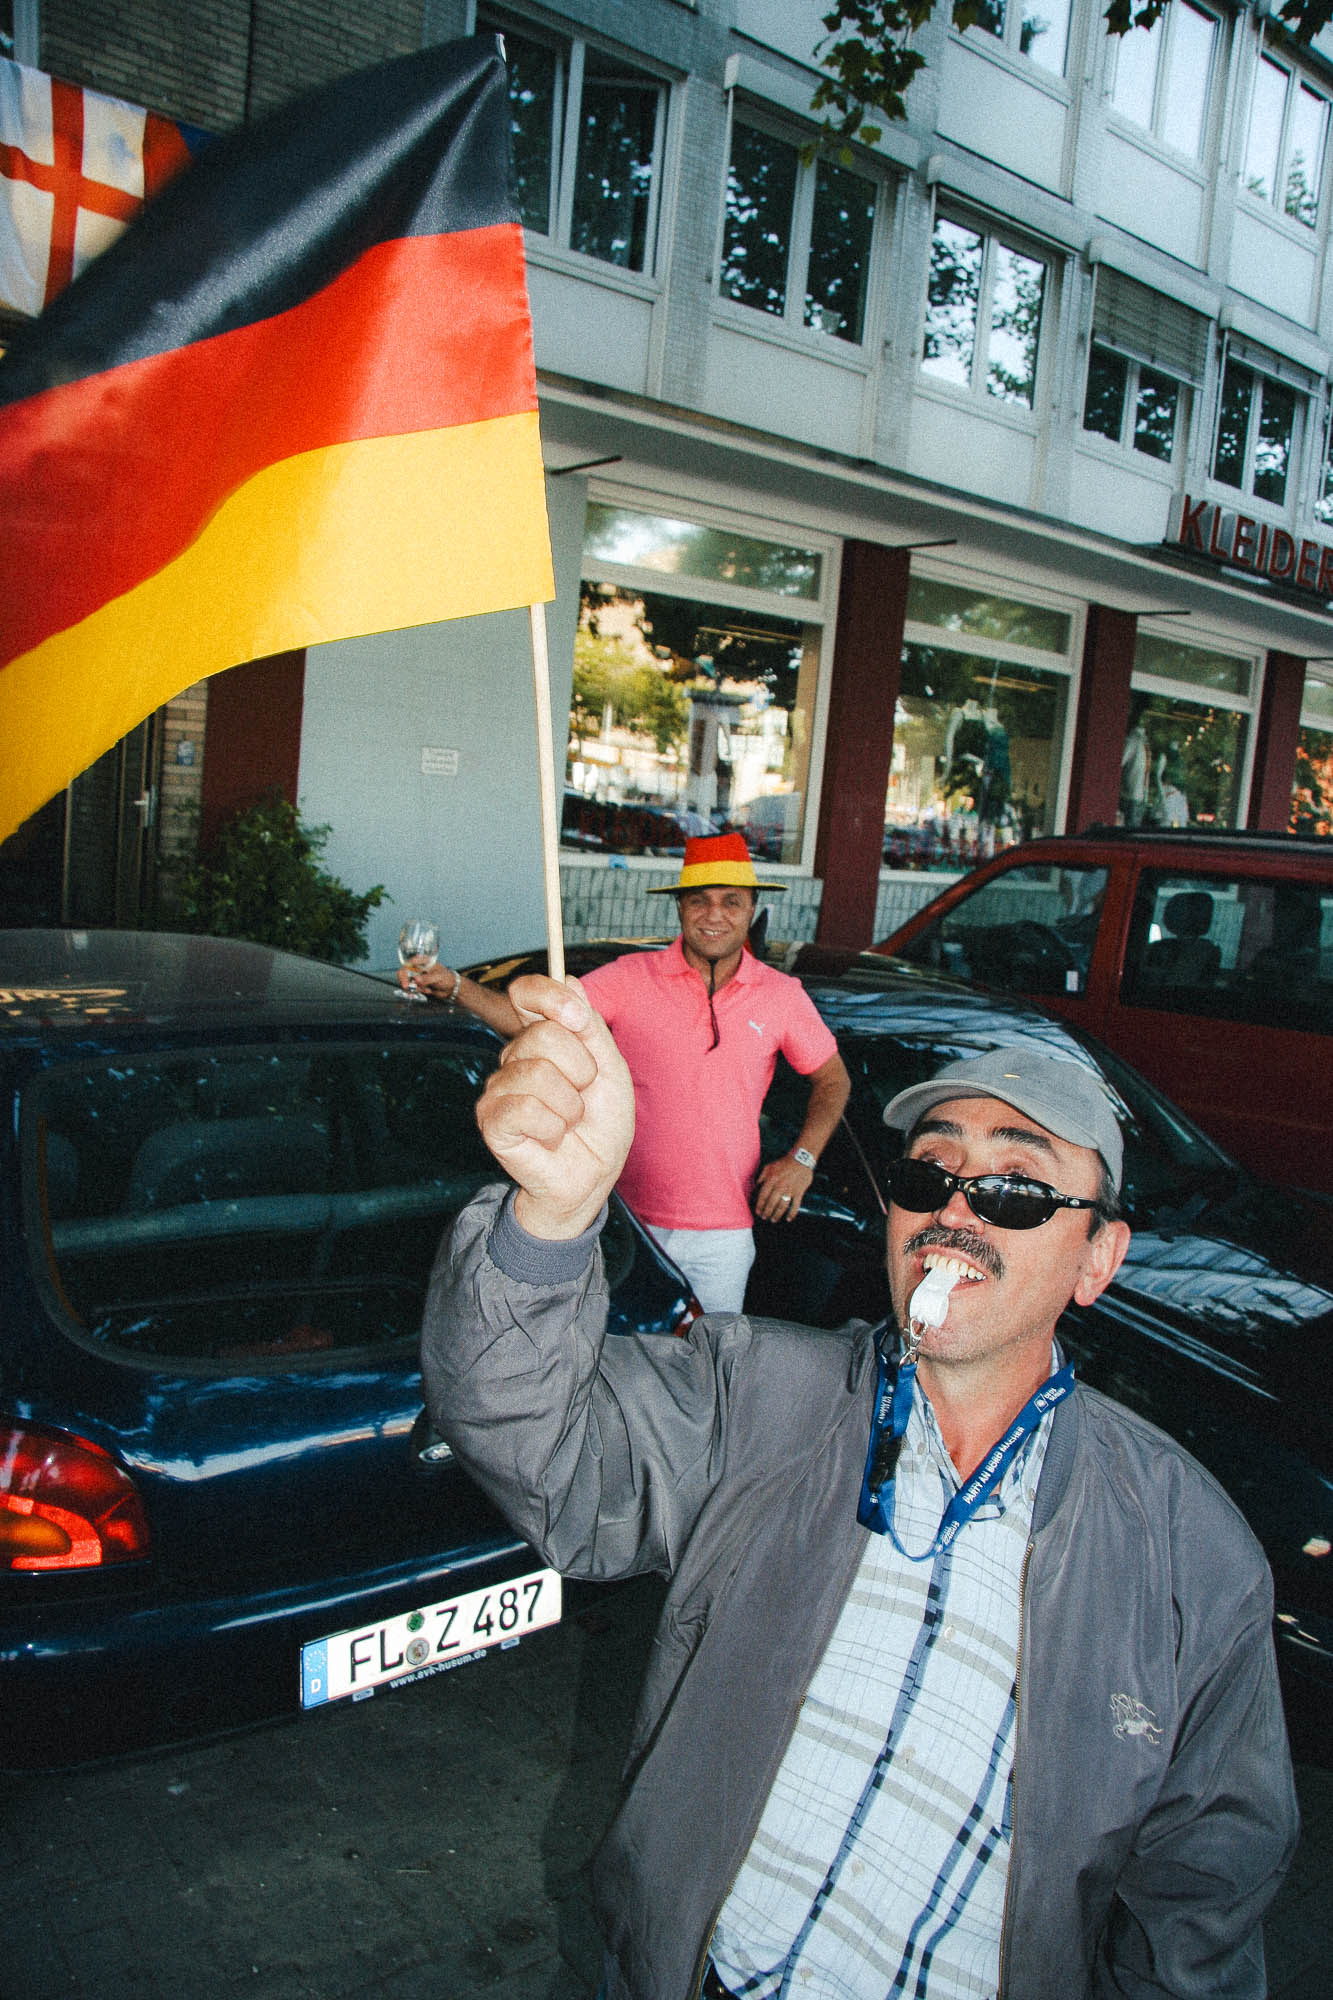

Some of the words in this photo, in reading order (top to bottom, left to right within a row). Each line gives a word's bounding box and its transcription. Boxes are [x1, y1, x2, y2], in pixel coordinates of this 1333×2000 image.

[1179, 494, 1333, 595] KLEIDER
[962, 1480, 983, 1504] PARTY
[979, 1470, 991, 1484] AN
[985, 1450, 1003, 1474] BORD
[350, 1629, 404, 1683] FL
[436, 1605, 460, 1653] Z
[473, 1578, 544, 1637] 487
[311, 1678, 321, 1694] D
